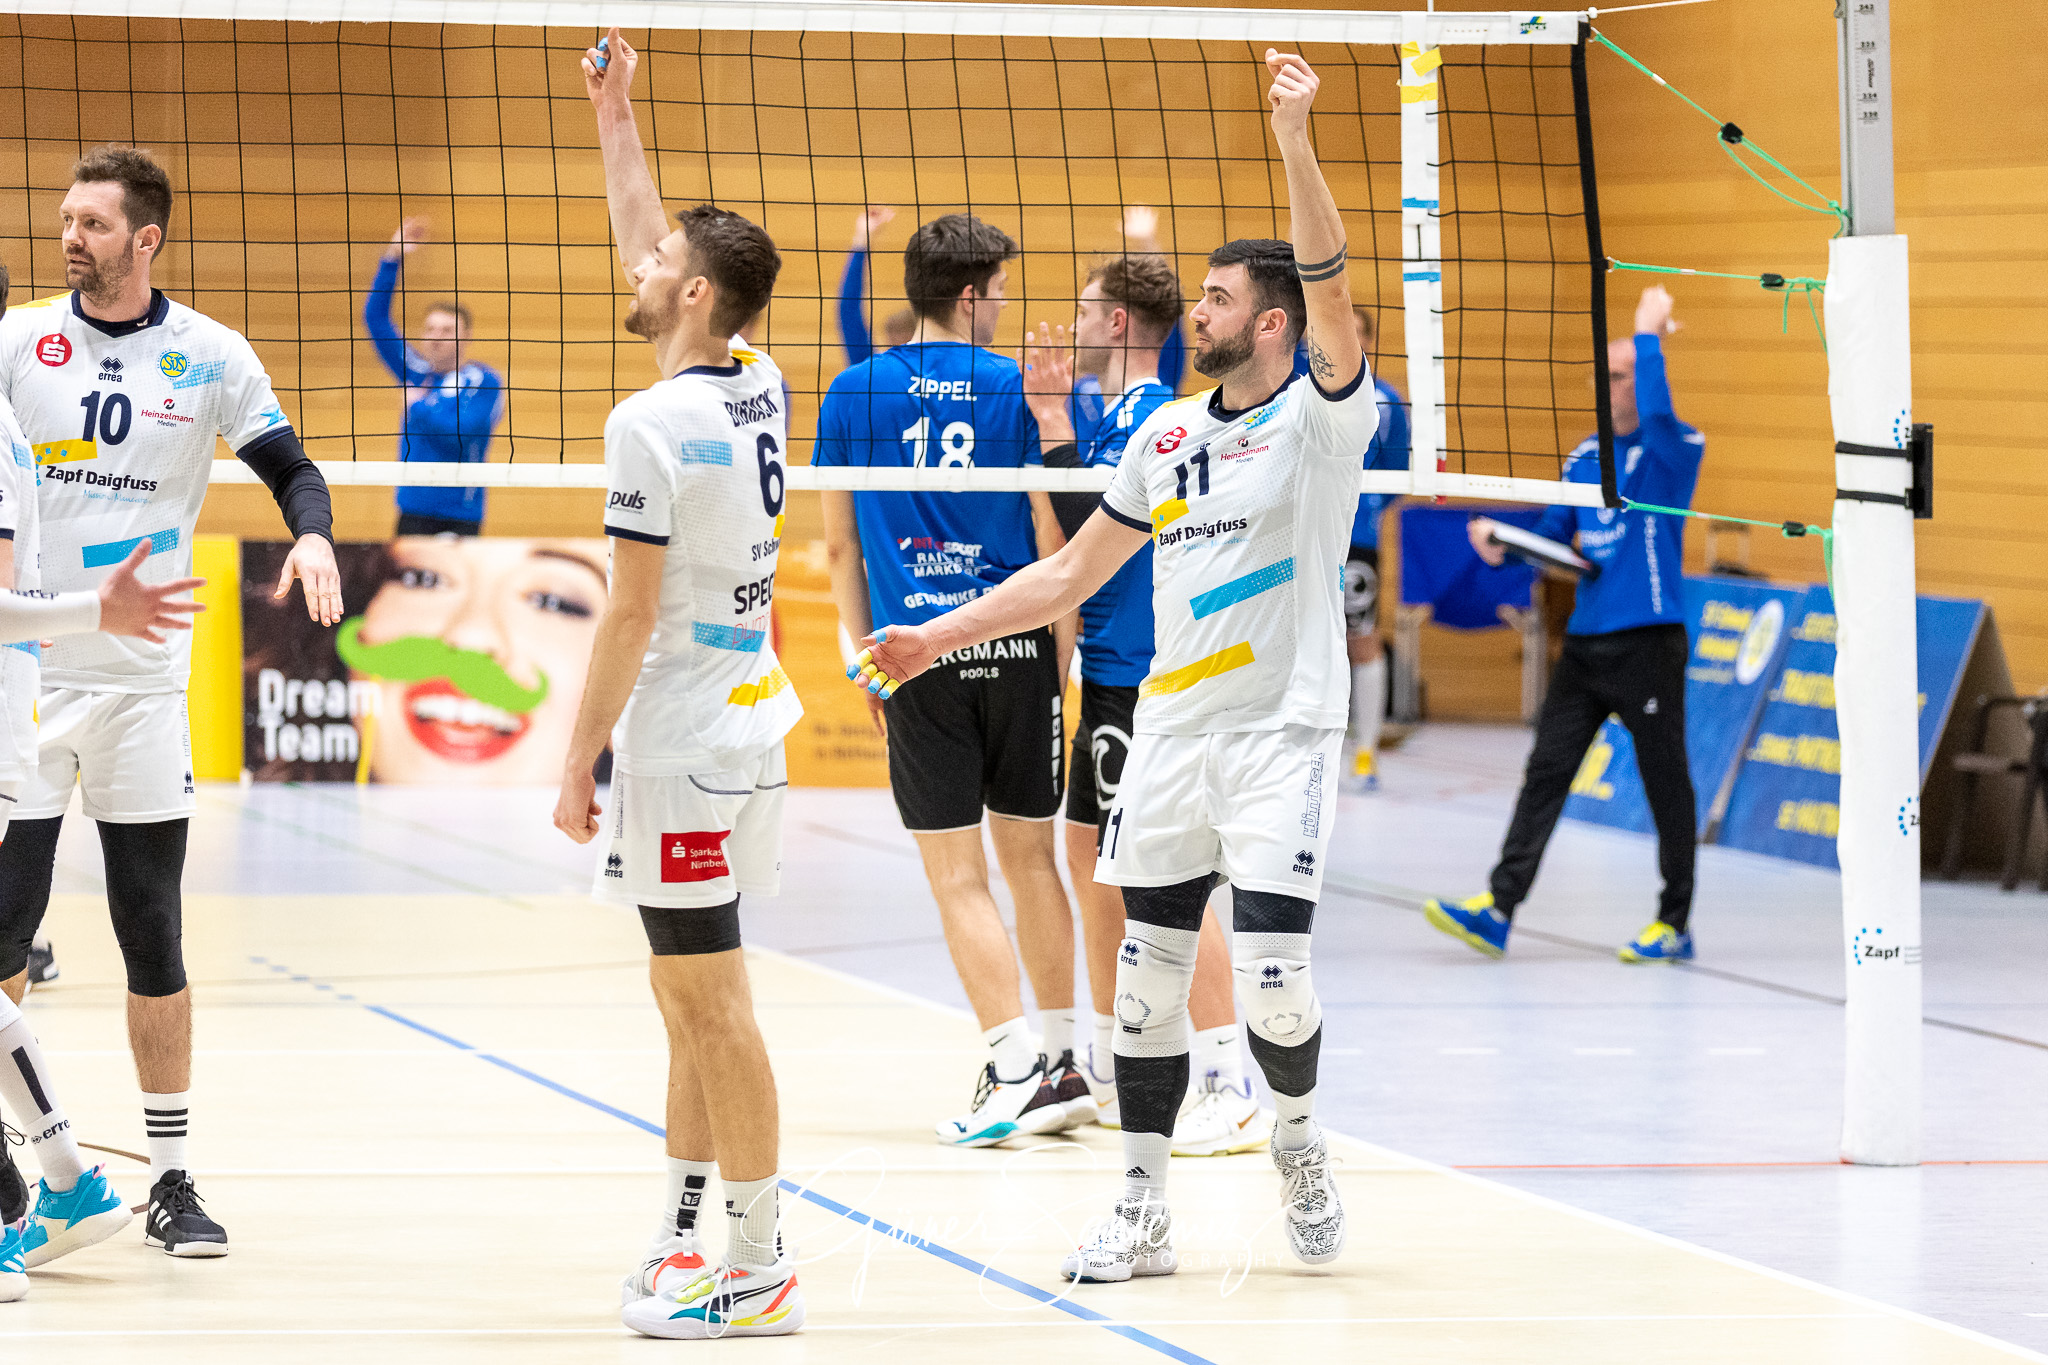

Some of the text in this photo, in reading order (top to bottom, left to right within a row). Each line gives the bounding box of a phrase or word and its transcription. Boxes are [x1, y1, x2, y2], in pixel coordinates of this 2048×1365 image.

[98, 372, 123, 383] errea
[907, 376, 978, 402] ZIPPEL
[80, 390, 132, 446] 10
[140, 409, 194, 423] Heinzelmann
[156, 419, 177, 428] Medien
[902, 416, 976, 468] 18
[1220, 445, 1269, 461] Heinzelmann
[45, 465, 158, 492] Zapf Daigfuss
[757, 431, 785, 518] 6
[1174, 447, 1210, 500] 11
[608, 490, 647, 510] puls
[1158, 518, 1248, 546] Zapf Daigfuss
[751, 542, 762, 561] SV
[959, 667, 1000, 680] POOLS
[257, 668, 383, 717] Dream
[258, 715, 360, 763] Team
[1292, 863, 1314, 877] errea
[1120, 954, 1138, 967] errea
[1864, 945, 1900, 961] Zapf
[1260, 979, 1283, 989] errea
